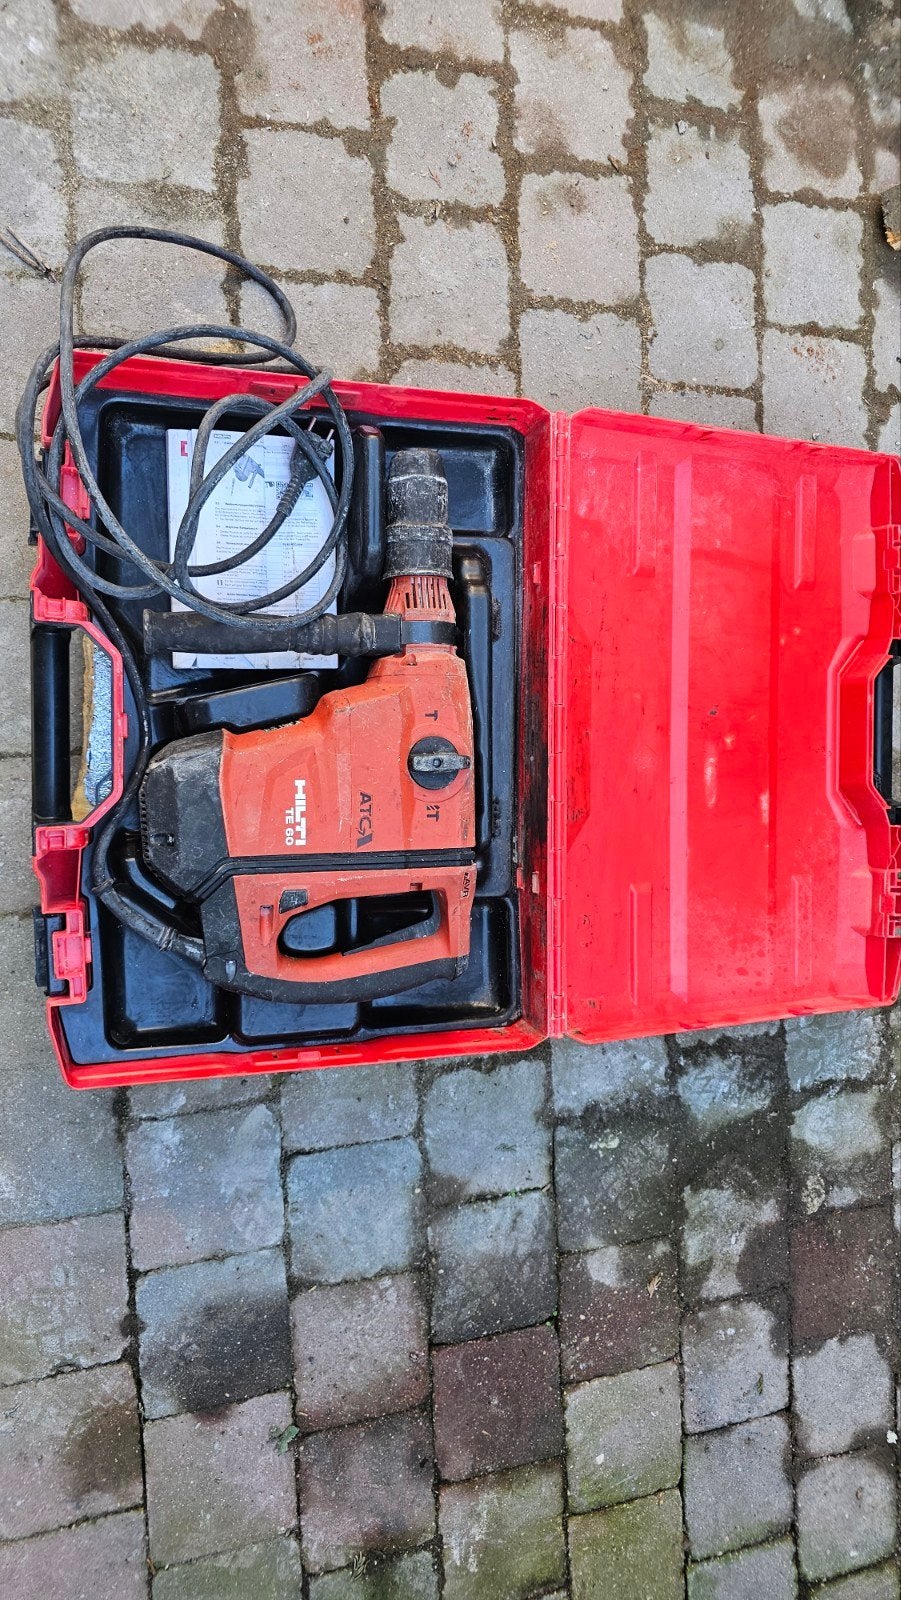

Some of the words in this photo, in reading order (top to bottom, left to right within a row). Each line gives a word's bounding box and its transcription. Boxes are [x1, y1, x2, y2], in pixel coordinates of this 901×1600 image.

[285, 808, 294, 824] TE
[294, 779, 306, 846] HILTI
[285, 830, 294, 846] 60
[462, 878, 471, 898] AVR
